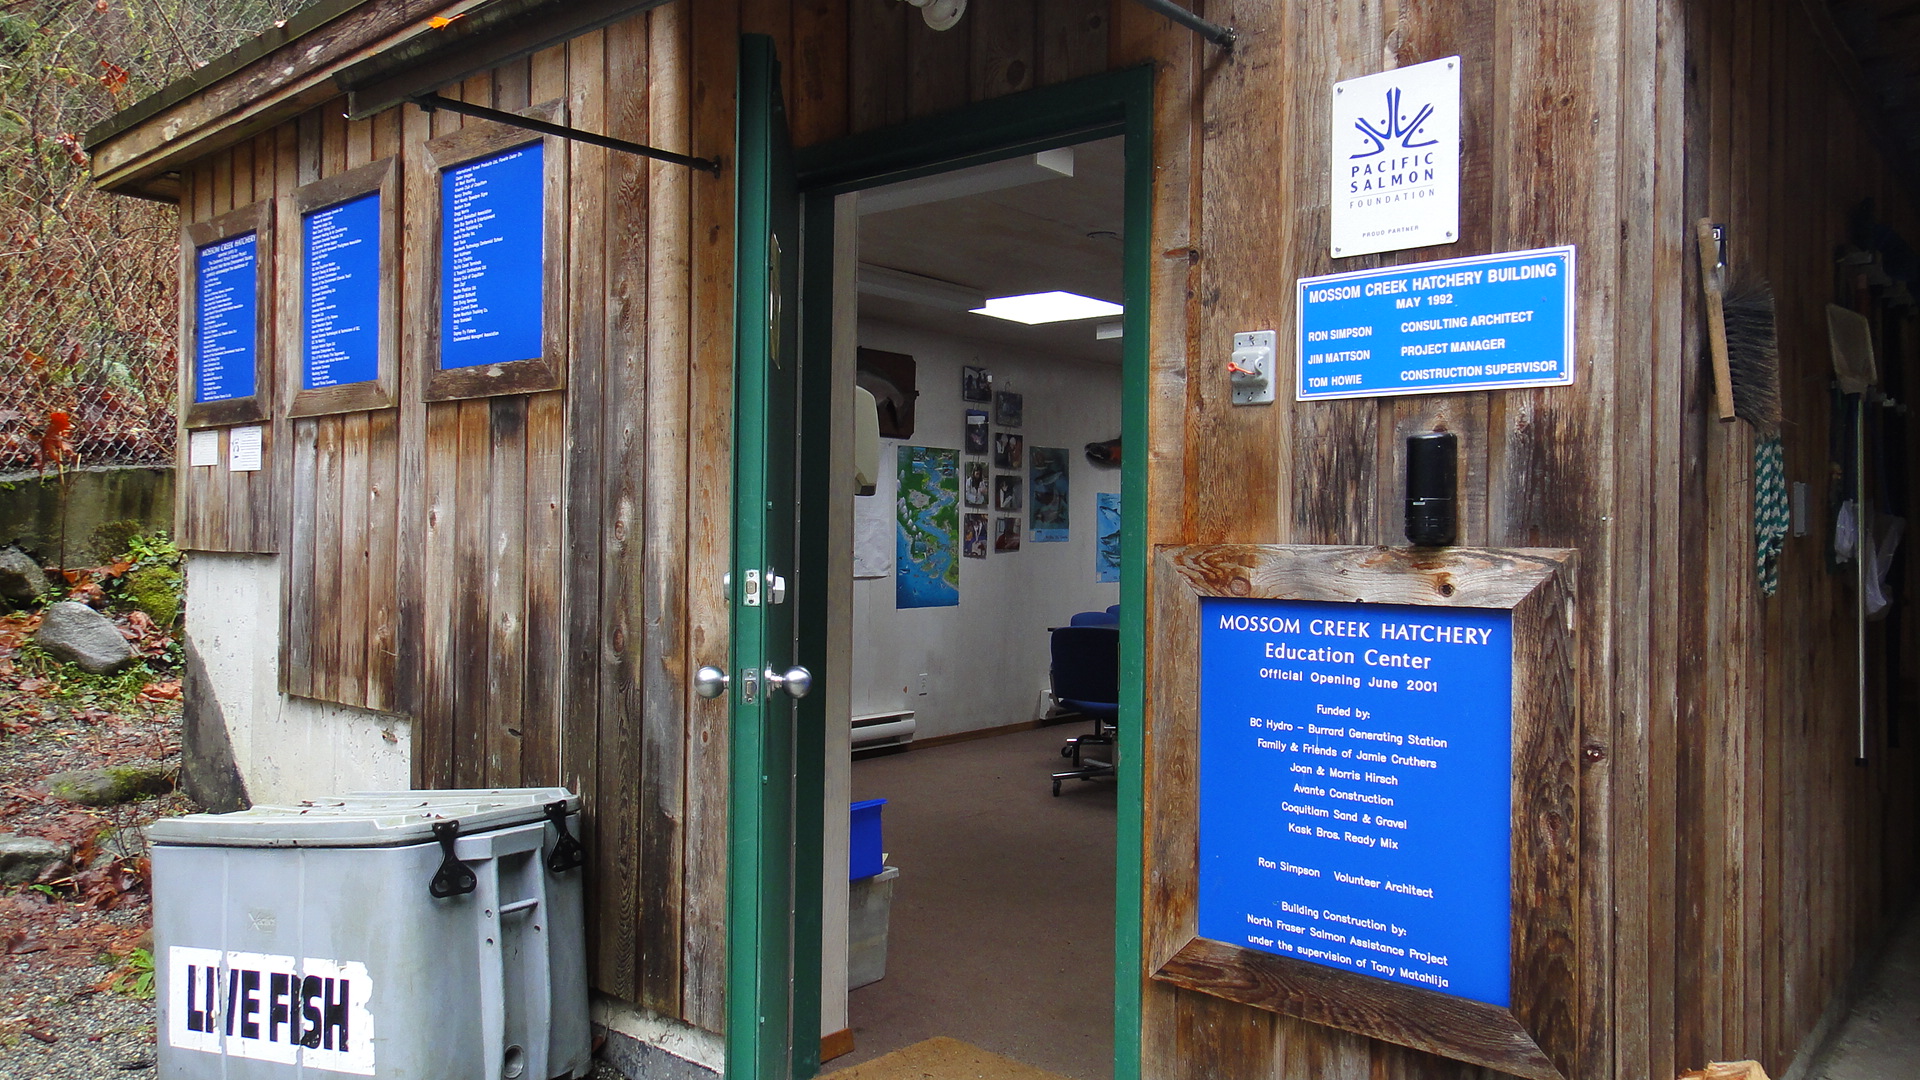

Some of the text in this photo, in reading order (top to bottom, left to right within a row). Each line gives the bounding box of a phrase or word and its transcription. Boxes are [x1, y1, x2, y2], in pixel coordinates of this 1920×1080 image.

[1351, 153, 1434, 178] PACIFIC
[1350, 169, 1434, 193] SALMON
[1349, 188, 1435, 209] FOUNDATION
[1362, 225, 1419, 238] PROUD PARTNER
[1309, 262, 1557, 303] MOSSOM CREEK HATCHERY BUILDING
[1396, 293, 1453, 309] MAY 1992
[1308, 326, 1372, 342] RON SIMPSON
[1400, 310, 1534, 333] CONSULTING ARCHITECT
[1307, 349, 1371, 365] JIM MATTSON
[1401, 338, 1506, 357] PROJECT MANAGER
[1308, 374, 1362, 388] TOM HOWIE
[1400, 360, 1558, 381] CONSTRUCTION SUPERVISOR
[1219, 615, 1492, 645] MOSSOM CREEK HATCHERY
[1265, 642, 1432, 670] Education Center
[1259, 668, 1437, 693] Official Opening June 2001
[1316, 704, 1370, 721] Funded by:
[1250, 717, 1262, 728] BC
[1266, 719, 1294, 731] Hydro
[1308, 723, 1344, 737] Burrard
[1348, 728, 1403, 746] Generating
[1407, 734, 1448, 748] Station
[1257, 738, 1437, 769] Family & Friends of Jamie Cruthers
[1290, 762, 1398, 786] Joan & Morris Hirsch
[1293, 783, 1394, 806] Avante Construction
[1281, 801, 1407, 830] Coquitlam Sand & Gravel
[1288, 822, 1399, 850] Kask Bros. Ready Mix
[1258, 857, 1434, 899] Ron Simpson Volunteer Architect
[1281, 901, 1407, 937] Building Construction by:
[1247, 913, 1448, 966] North Fraser Salmon Assistance Project
[1248, 935, 1449, 988] under the supervision of Tony Matahlija
[187, 964, 349, 1052] LIVE FISH
